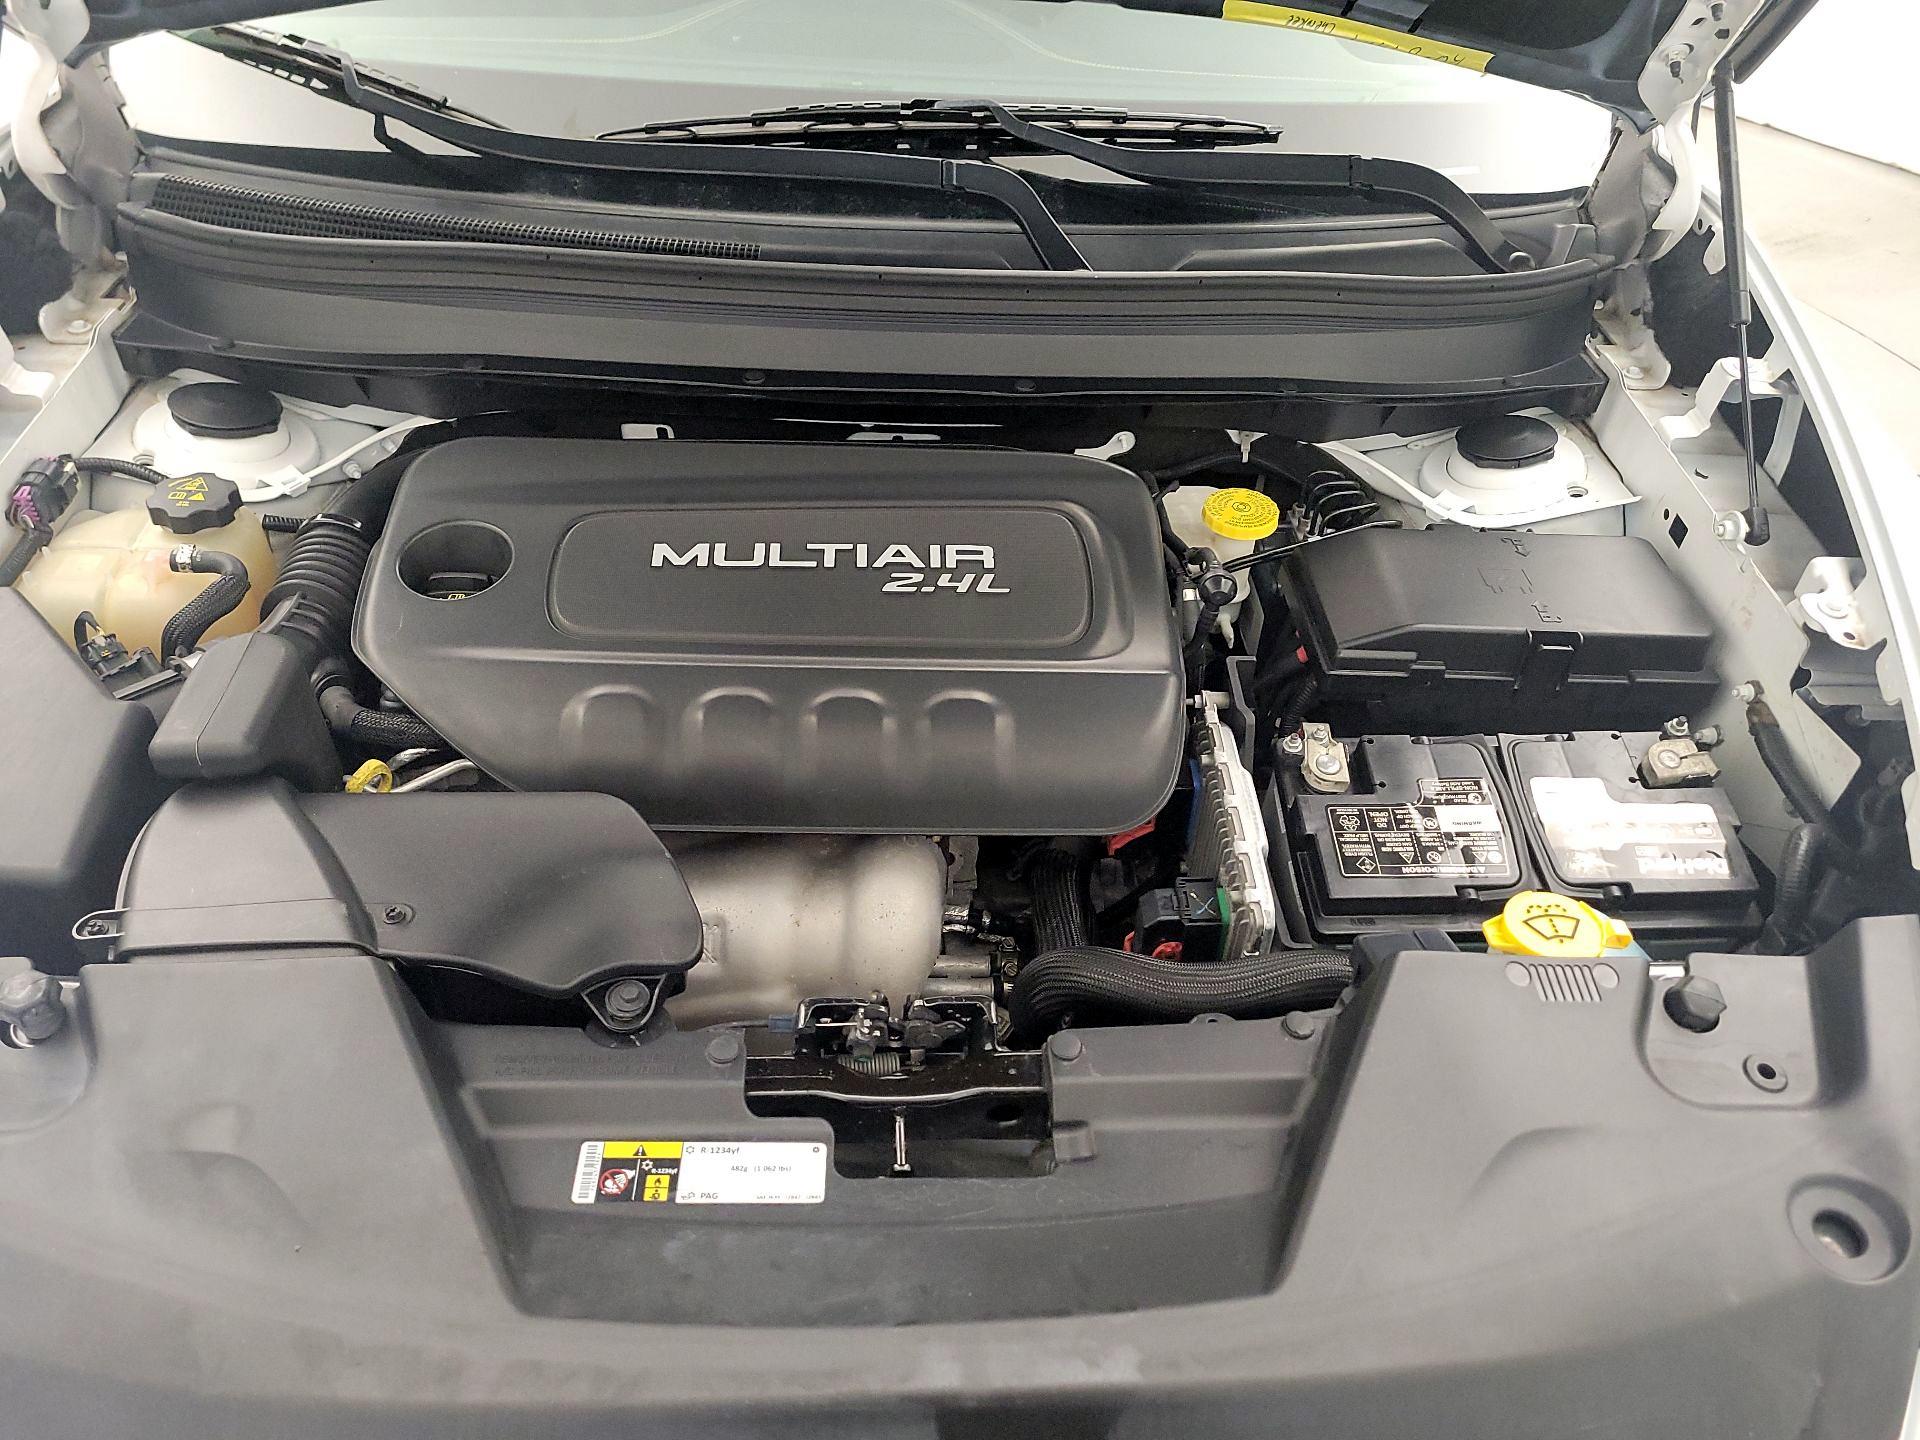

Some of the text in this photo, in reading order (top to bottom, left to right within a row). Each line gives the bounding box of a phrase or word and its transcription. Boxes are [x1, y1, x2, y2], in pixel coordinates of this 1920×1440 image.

[650, 542, 996, 569] MULTIAIR
[881, 573, 1012, 594] 2.4L
[700, 1192, 719, 1200] PAG
